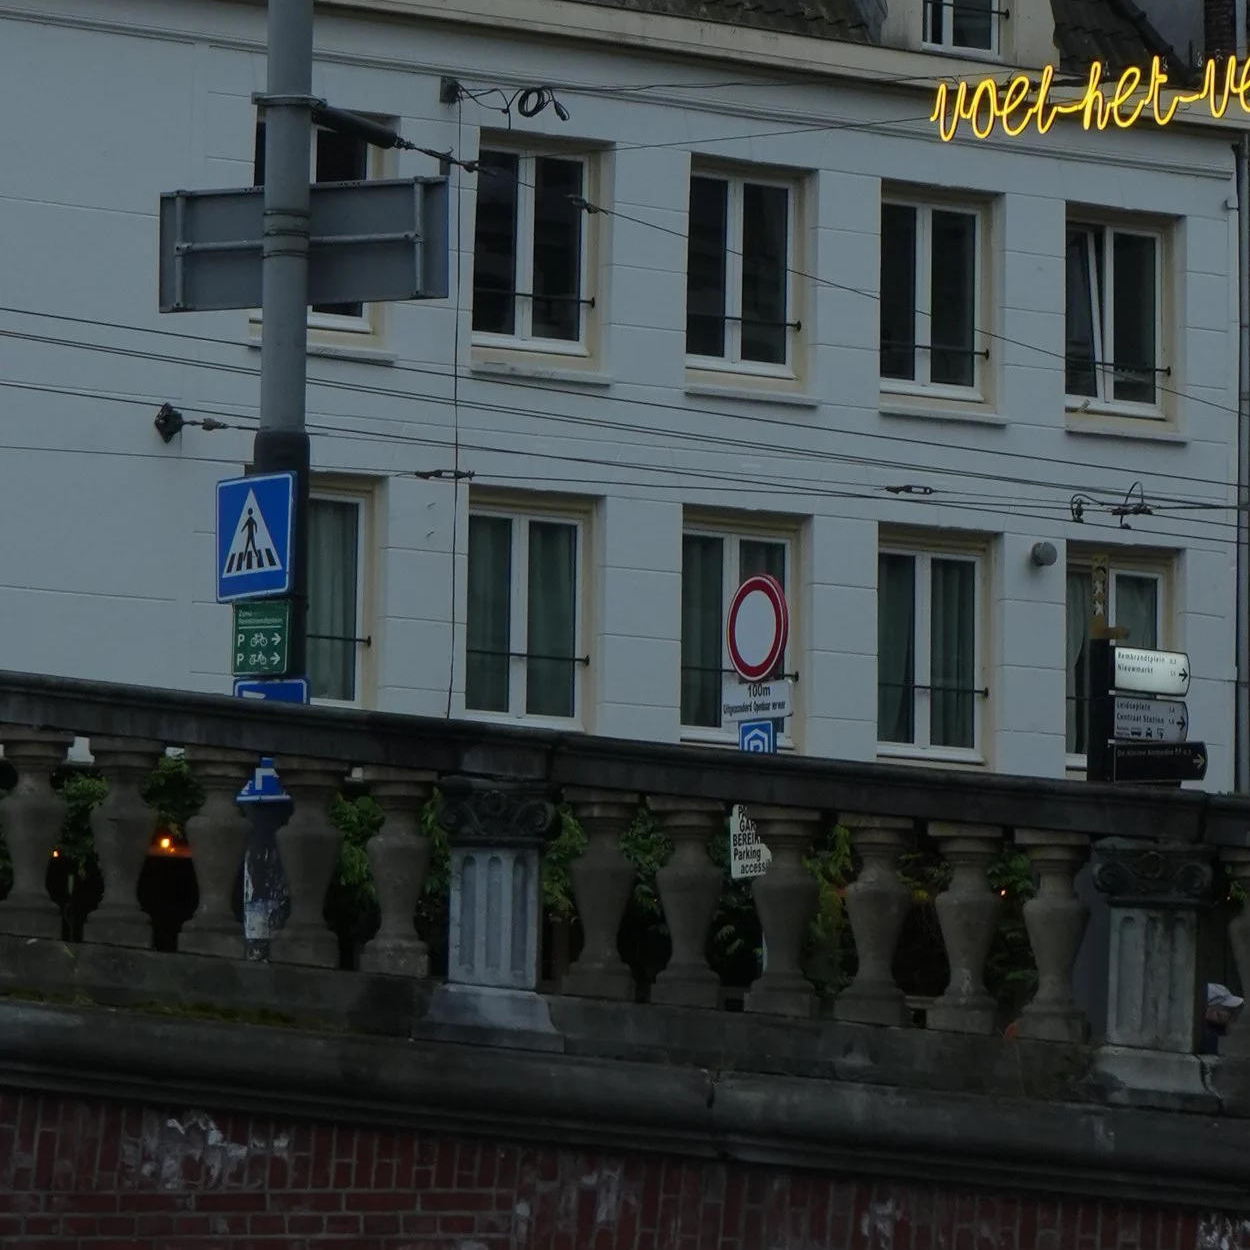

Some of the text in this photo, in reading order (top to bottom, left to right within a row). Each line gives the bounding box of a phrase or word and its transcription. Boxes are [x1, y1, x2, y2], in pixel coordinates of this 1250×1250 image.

[930, 64, 1059, 142] voel
[1080, 55, 1178, 131] het
[237, 634, 245, 647] P
[236, 653, 245, 667] P
[1117, 664, 1153, 674] Nieuwmarkt
[748, 684, 771, 697] 100m
[1116, 701, 1151, 711] Leidseplein
[1116, 713, 1142, 722] Centraal
[1143, 715, 1165, 724] Station
[733, 847, 762, 862] Parking
